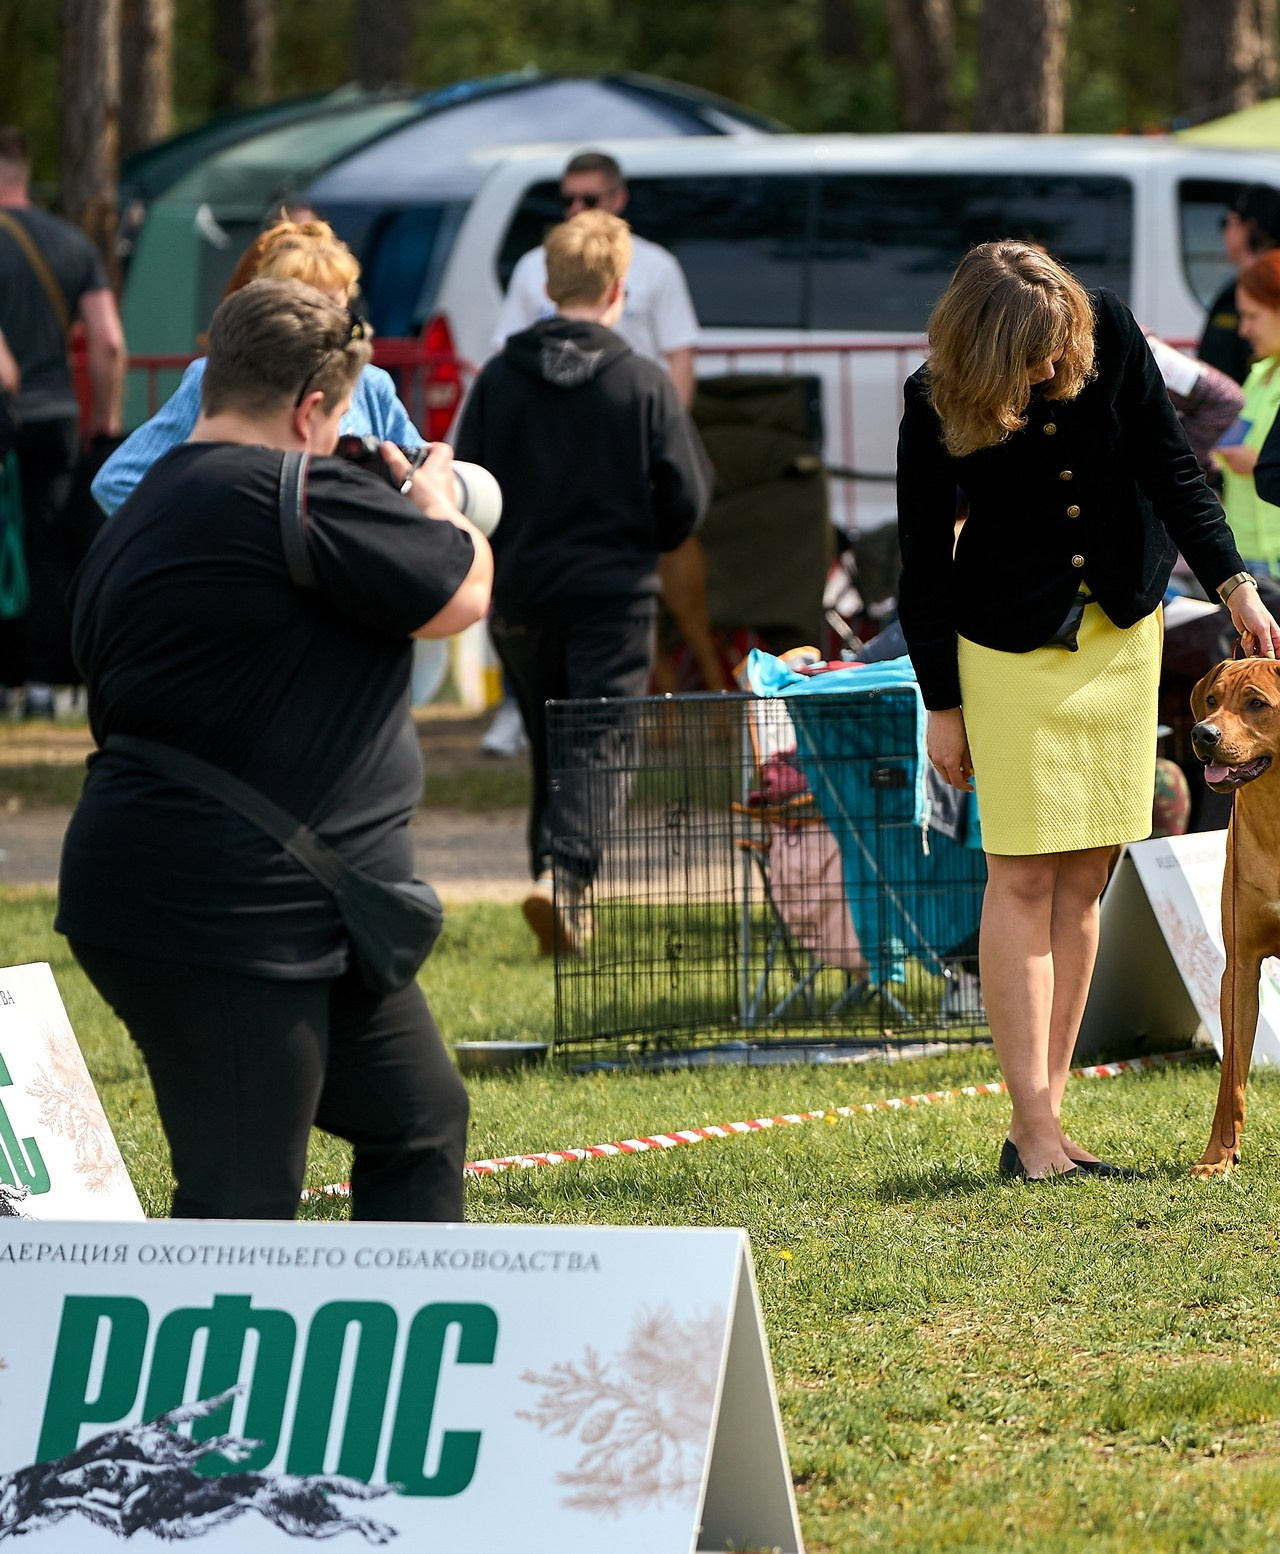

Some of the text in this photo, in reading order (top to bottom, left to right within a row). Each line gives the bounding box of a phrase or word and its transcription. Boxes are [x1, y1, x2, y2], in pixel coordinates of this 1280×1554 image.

[138, 1244, 346, 1269] ОХОТНИЧЬЕГО
[354, 1247, 601, 1273] СОБАКОВОДСТВА
[36, 1293, 500, 1497] РФОС
